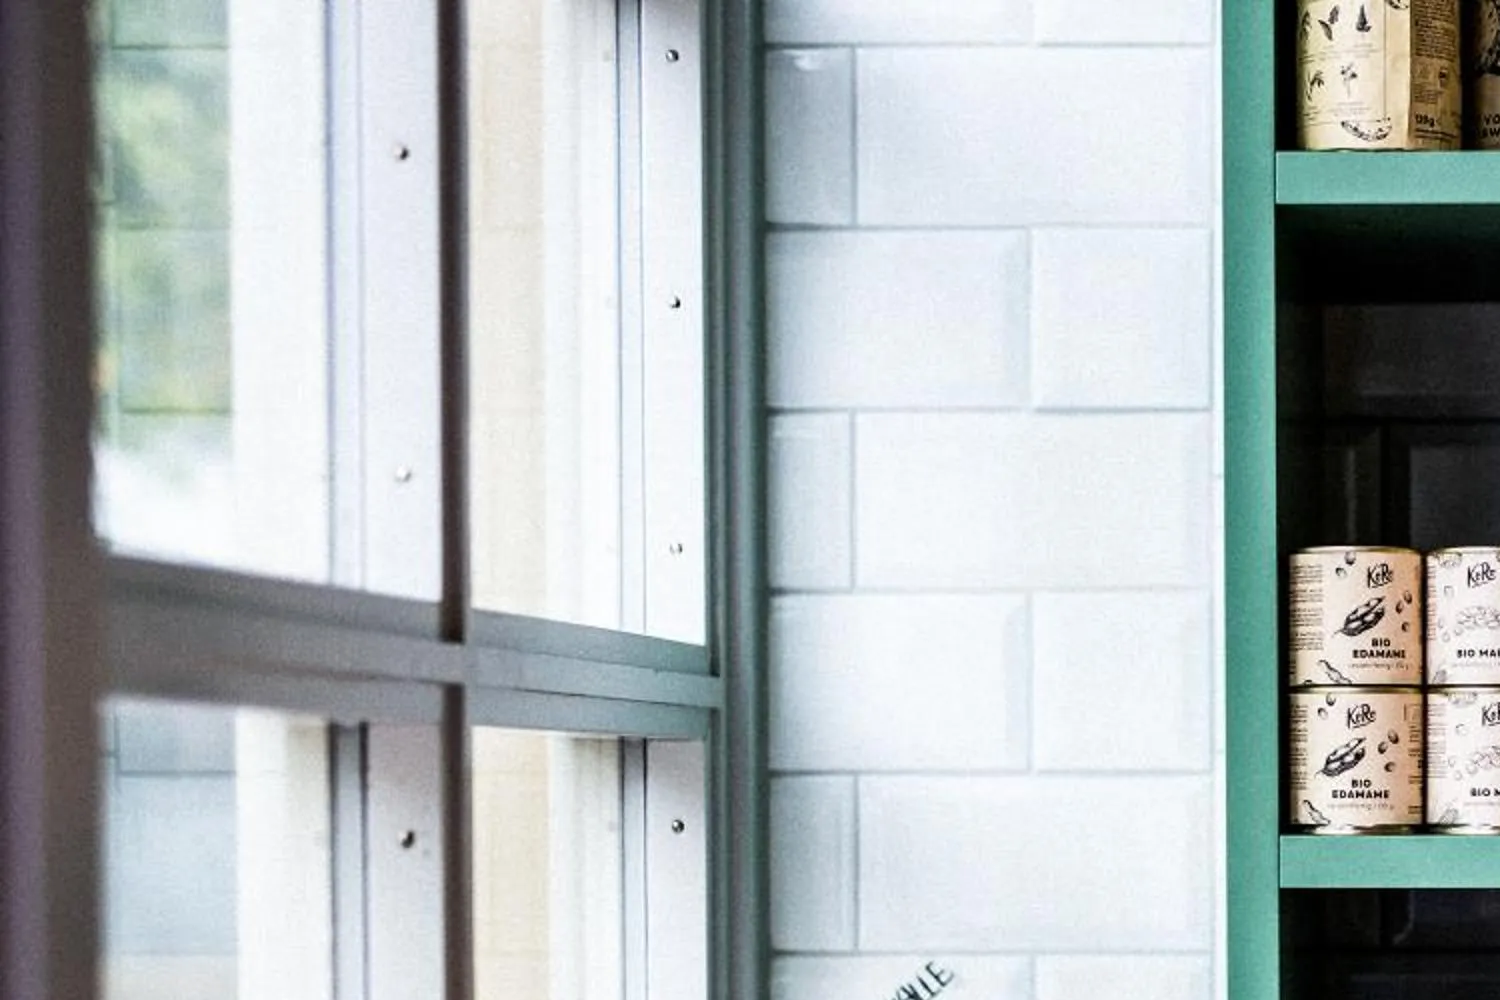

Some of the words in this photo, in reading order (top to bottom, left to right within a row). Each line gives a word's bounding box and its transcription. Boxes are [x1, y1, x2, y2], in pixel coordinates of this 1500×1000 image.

[1371, 639, 1391, 648] BIO
[1352, 649, 1406, 659] EDAMAME
[1456, 649, 1476, 658] BIO
[1351, 779, 1372, 789] BIO
[1331, 789, 1390, 799] EDAMAME
[1470, 788, 1491, 798] BIO
